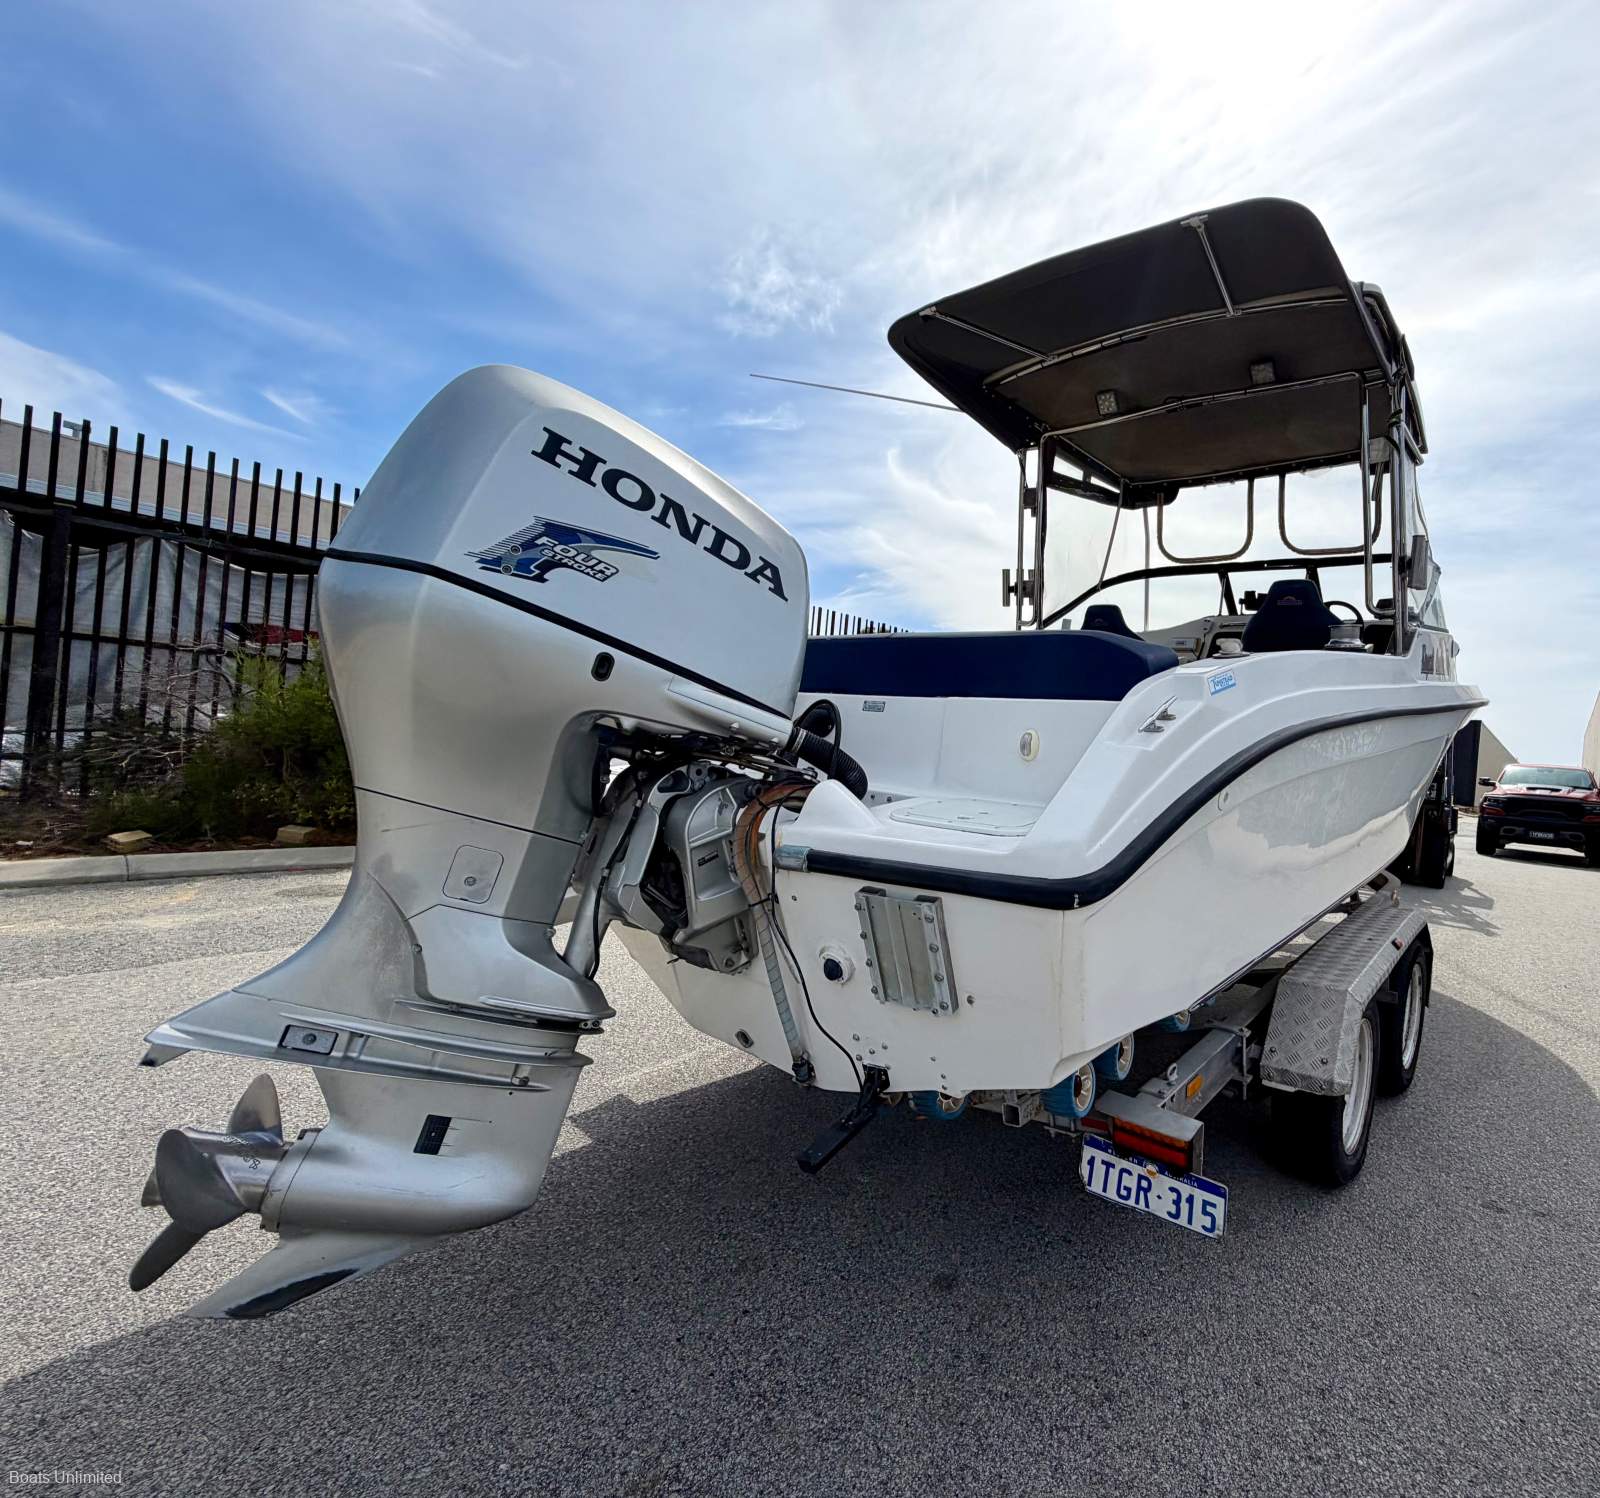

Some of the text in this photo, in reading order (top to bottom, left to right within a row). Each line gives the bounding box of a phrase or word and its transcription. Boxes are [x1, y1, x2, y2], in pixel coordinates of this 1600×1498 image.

[531, 426, 788, 602] HONDA
[534, 536, 618, 576] FOUR
[541, 548, 608, 581] STROKE
